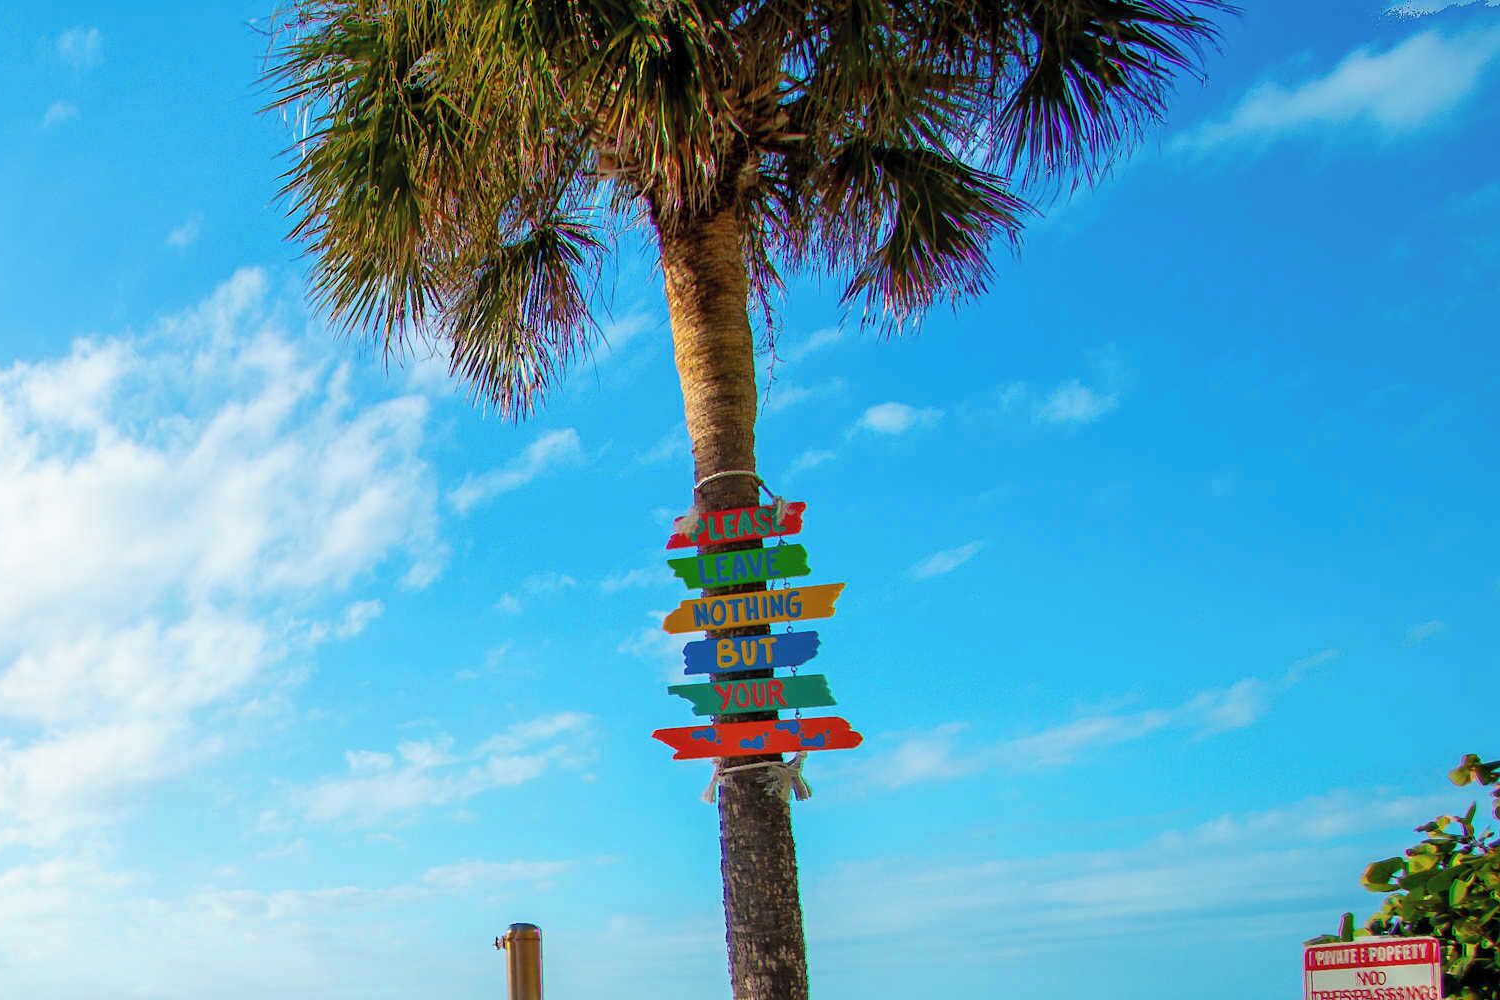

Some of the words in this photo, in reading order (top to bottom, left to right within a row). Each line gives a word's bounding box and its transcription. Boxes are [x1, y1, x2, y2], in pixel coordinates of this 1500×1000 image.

[698, 549, 782, 585] LEAVE
[692, 591, 803, 628] NOTHING
[716, 637, 777, 668] BUT
[713, 680, 787, 711] YOUR
[1356, 971, 1387, 986] NO
